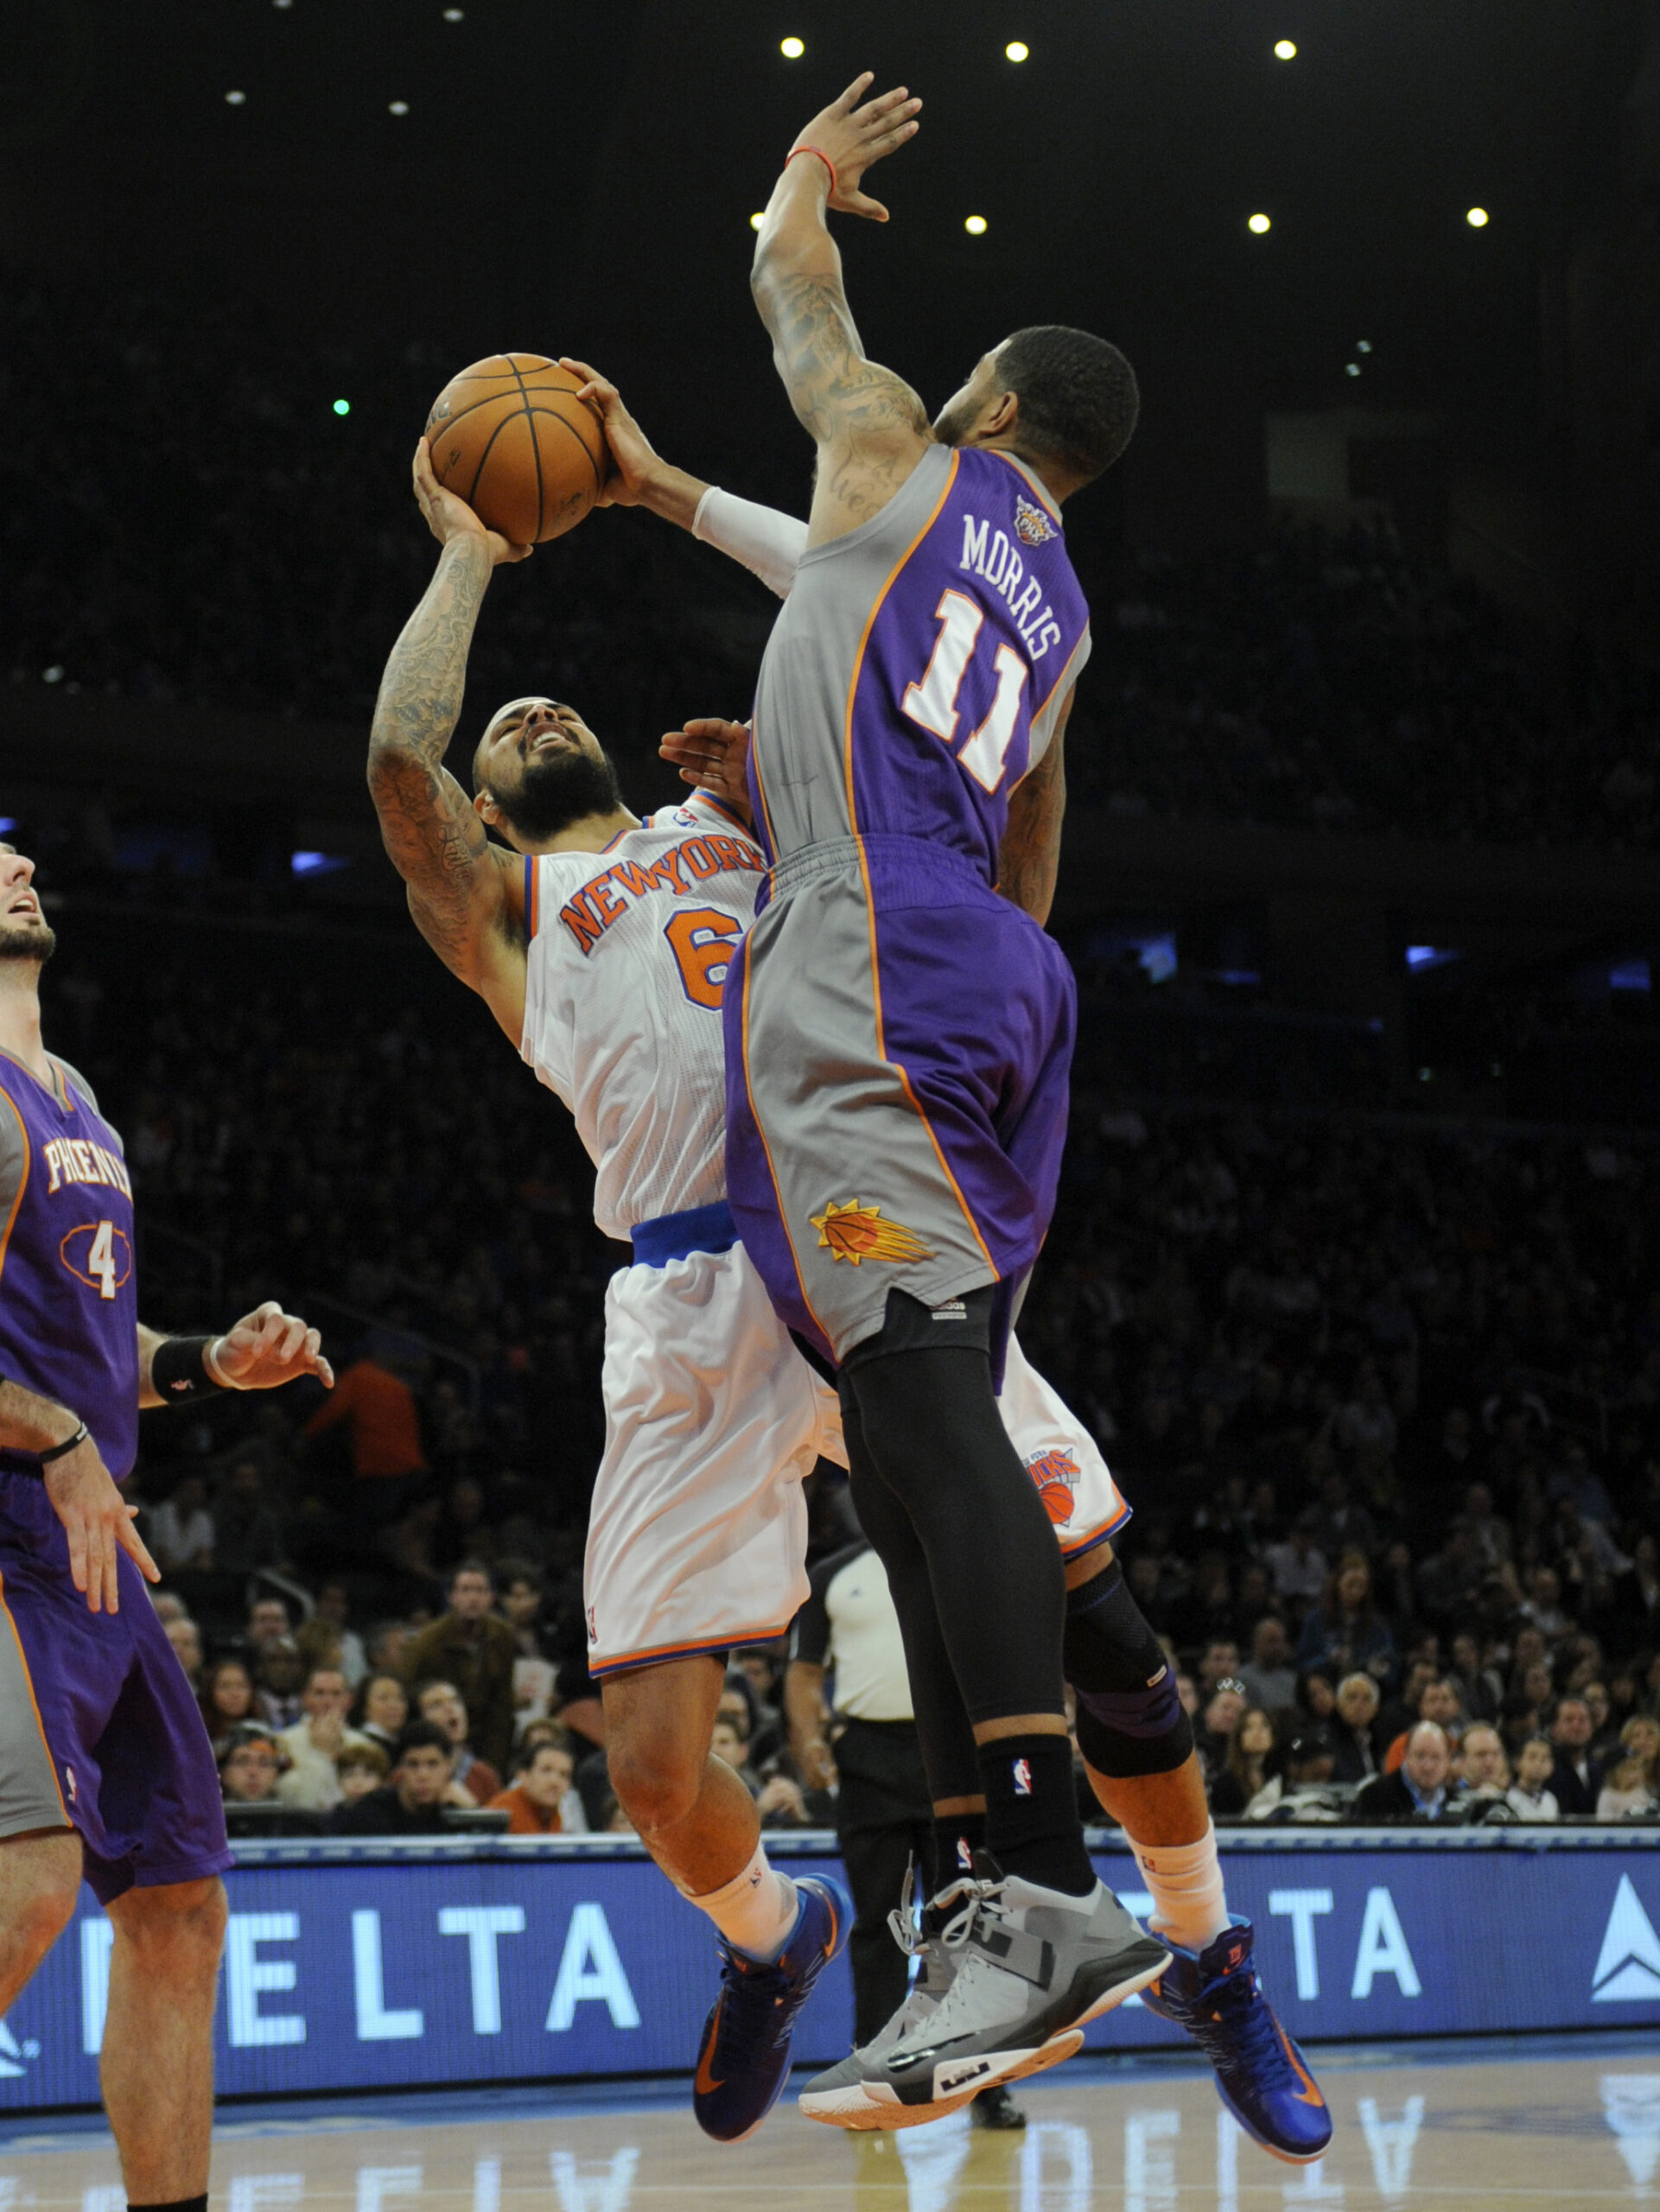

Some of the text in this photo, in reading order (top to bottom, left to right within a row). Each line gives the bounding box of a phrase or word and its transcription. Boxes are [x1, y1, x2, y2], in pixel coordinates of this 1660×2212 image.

[959, 514, 1062, 661] MORRIS
[901, 588, 1029, 796] 11
[559, 860, 663, 957] NEW
[663, 906, 744, 1012] 6
[88, 1219, 116, 1300] 4
[1027, 1449, 1082, 1487] ICKS
